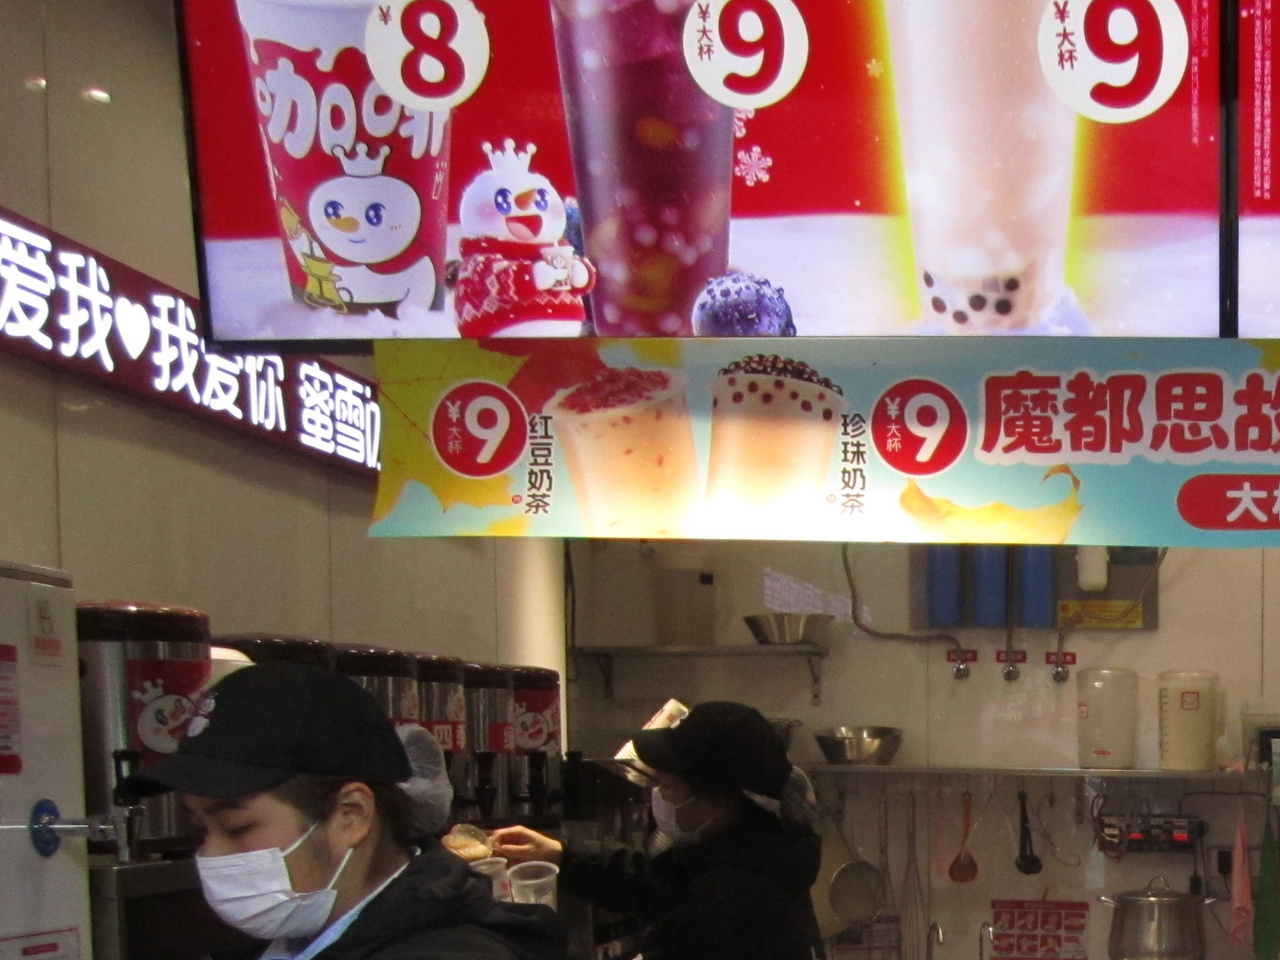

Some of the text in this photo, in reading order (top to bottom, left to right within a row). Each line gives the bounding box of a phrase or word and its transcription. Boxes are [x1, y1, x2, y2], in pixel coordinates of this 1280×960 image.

[464, 396, 513, 463] 9
[524, 415, 553, 515] 红豆奶茶
[840, 413, 867, 514] 珍珠奶茶
[903, 393, 951, 462] 9
